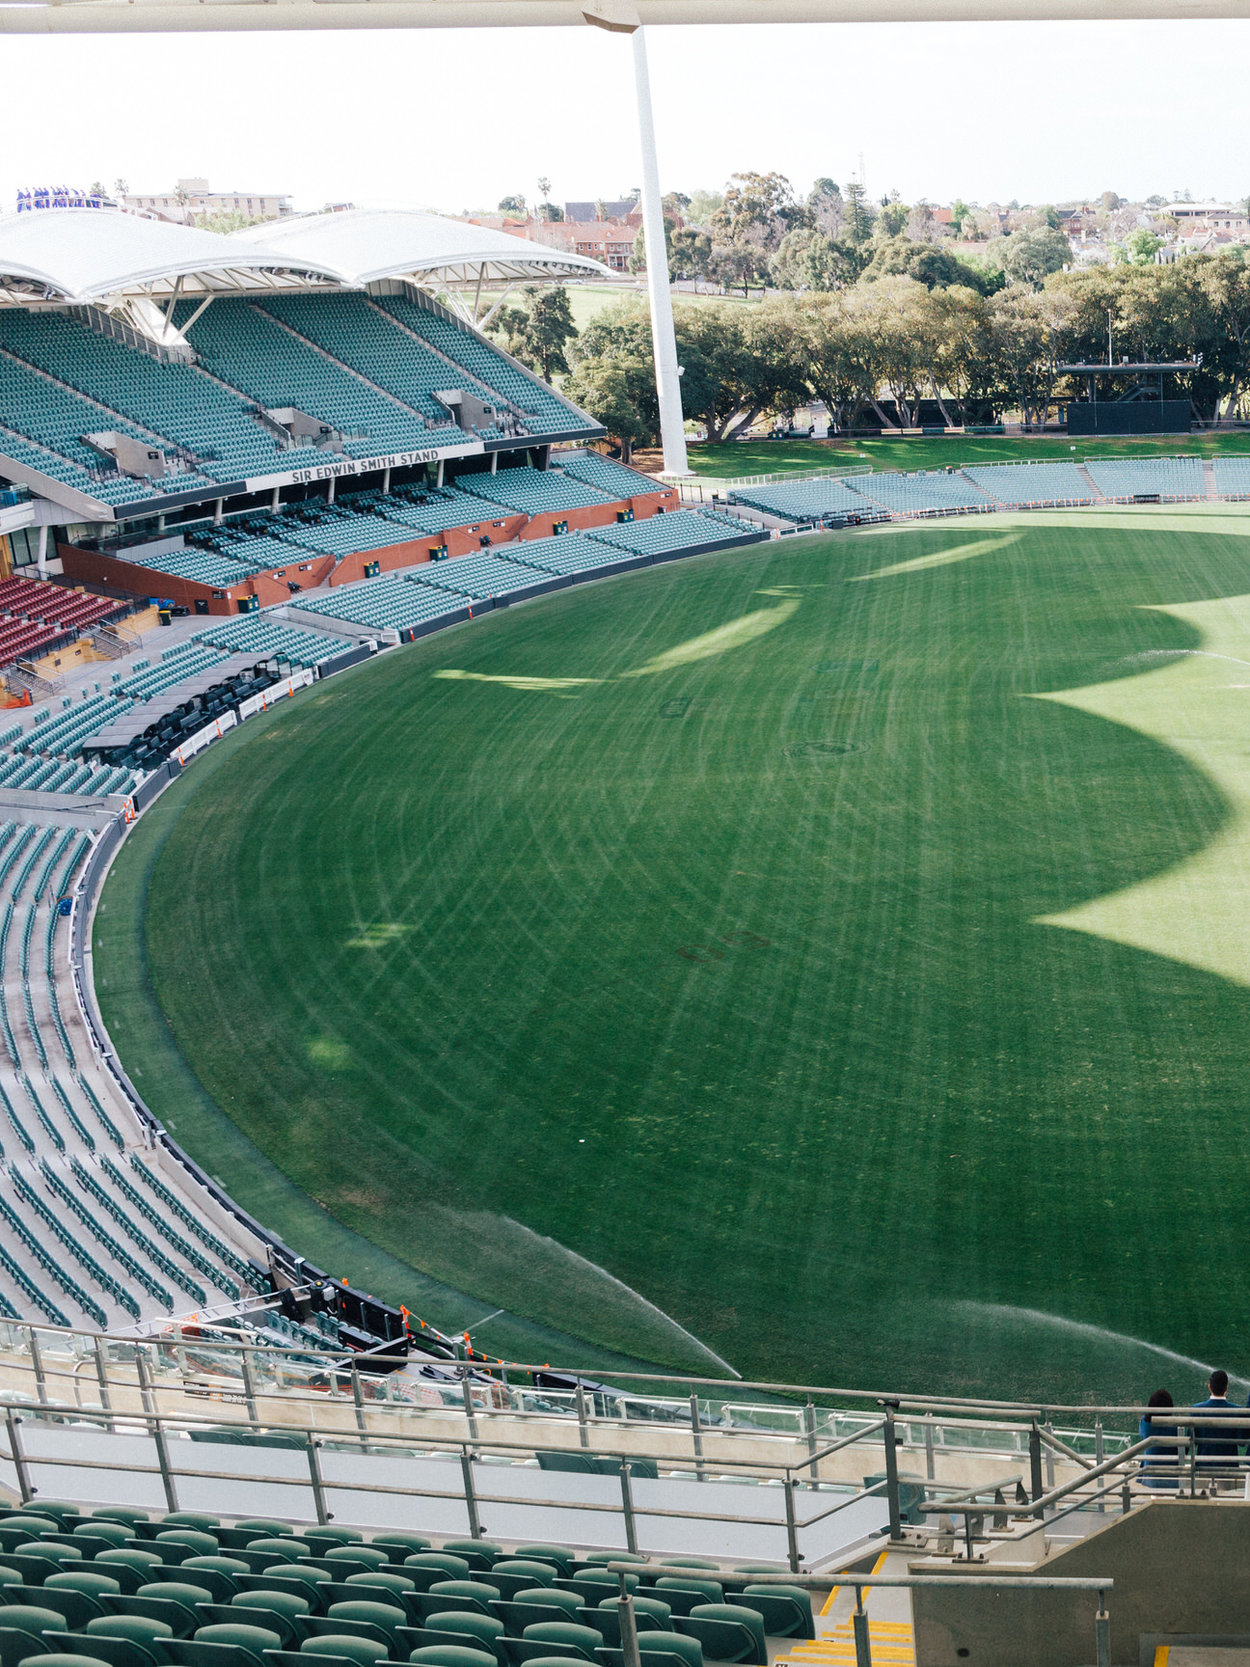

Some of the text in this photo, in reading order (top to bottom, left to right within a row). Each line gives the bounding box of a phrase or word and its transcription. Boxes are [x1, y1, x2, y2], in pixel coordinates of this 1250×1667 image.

[292, 450, 439, 483] SIR EDWIN SMITH STAND
